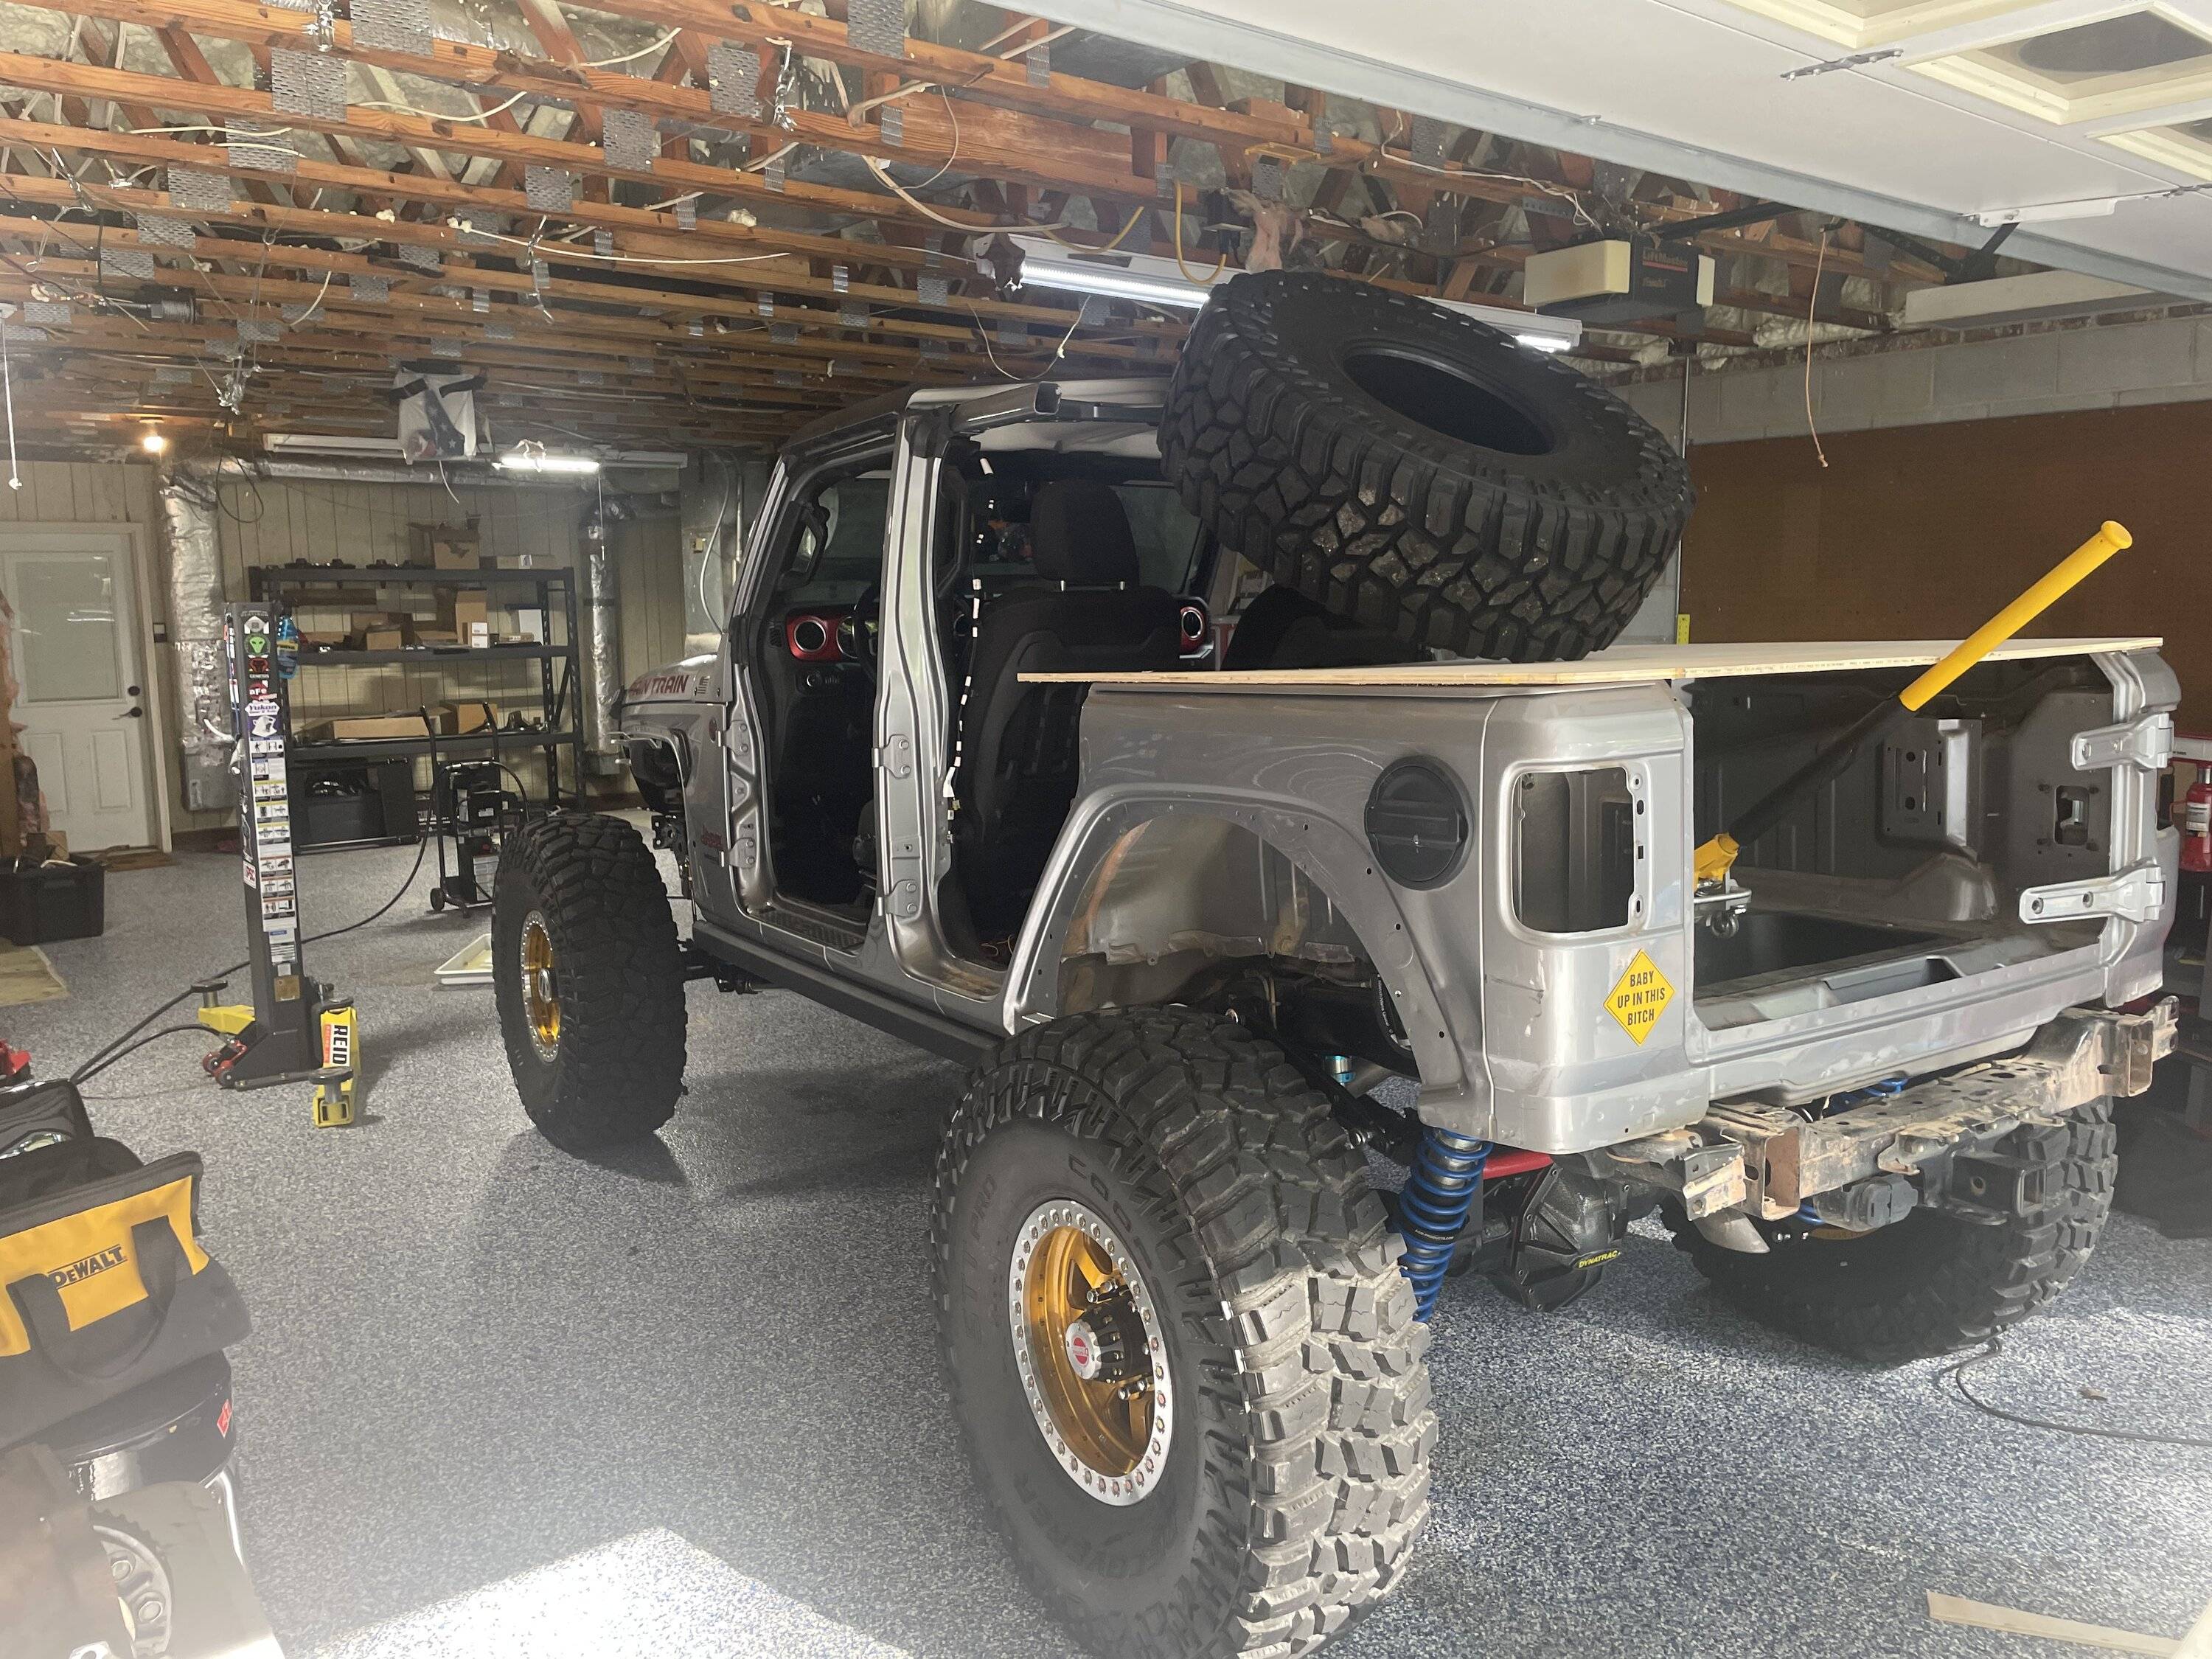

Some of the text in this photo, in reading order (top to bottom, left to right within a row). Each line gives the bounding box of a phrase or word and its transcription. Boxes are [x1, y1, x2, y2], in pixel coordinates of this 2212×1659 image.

[651, 675, 689, 695] TRAIN
[1630, 971, 1654, 987] BABY
[1618, 987, 1665, 1009] UP IN THIS
[1627, 1008, 1655, 1026] BITCH
[333, 1025, 348, 1064] REID
[1578, 1249, 1618, 1268] DYNATRAC
